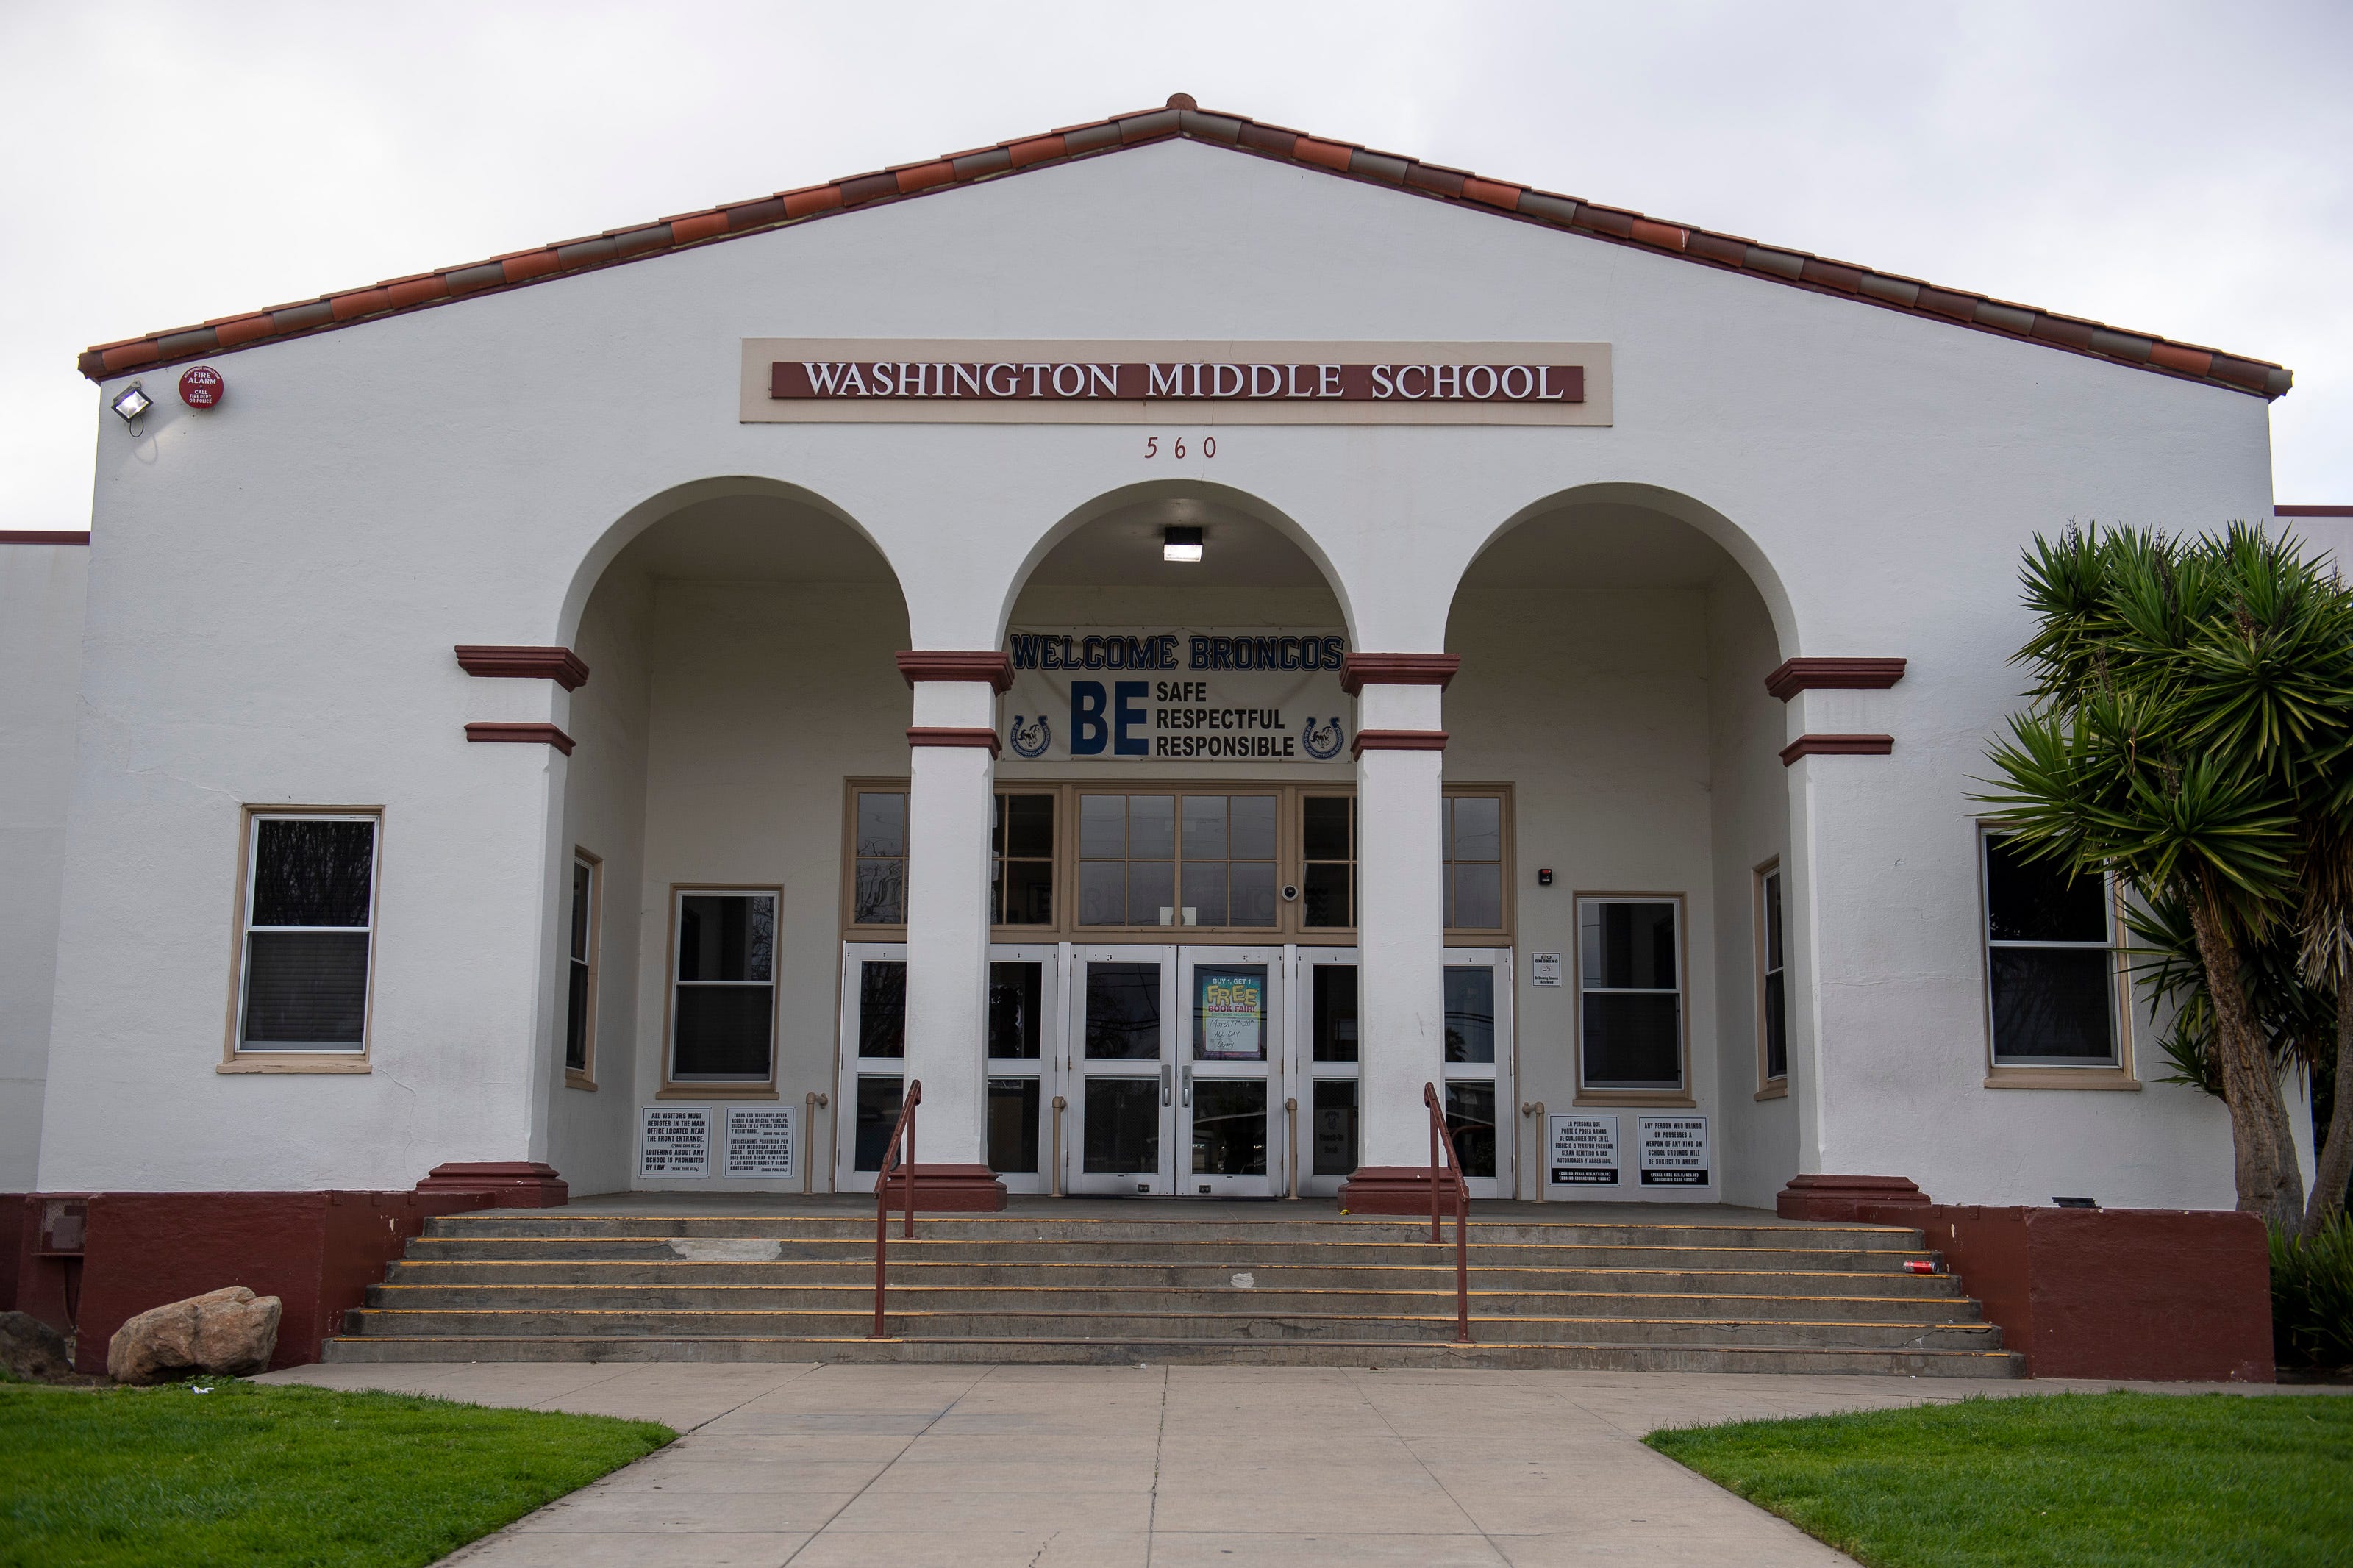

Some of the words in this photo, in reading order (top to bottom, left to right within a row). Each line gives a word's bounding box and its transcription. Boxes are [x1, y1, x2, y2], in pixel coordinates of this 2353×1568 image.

[802, 362, 1121, 397] WASHINGTON
[1146, 363, 1344, 398] MIDDLE
[1371, 364, 1564, 399] SCHOOL
[1010, 634, 1179, 670] WELCOME
[1189, 636, 1344, 671] BRONCOS
[1157, 681, 1207, 701] SAFE
[1071, 681, 1149, 755] BE
[1157, 709, 1285, 729] RESPECTFUL
[1157, 737, 1294, 756] RESPONSIBLE
[1207, 985, 1258, 1006] FREE
[1210, 1019, 1229, 1028] March
